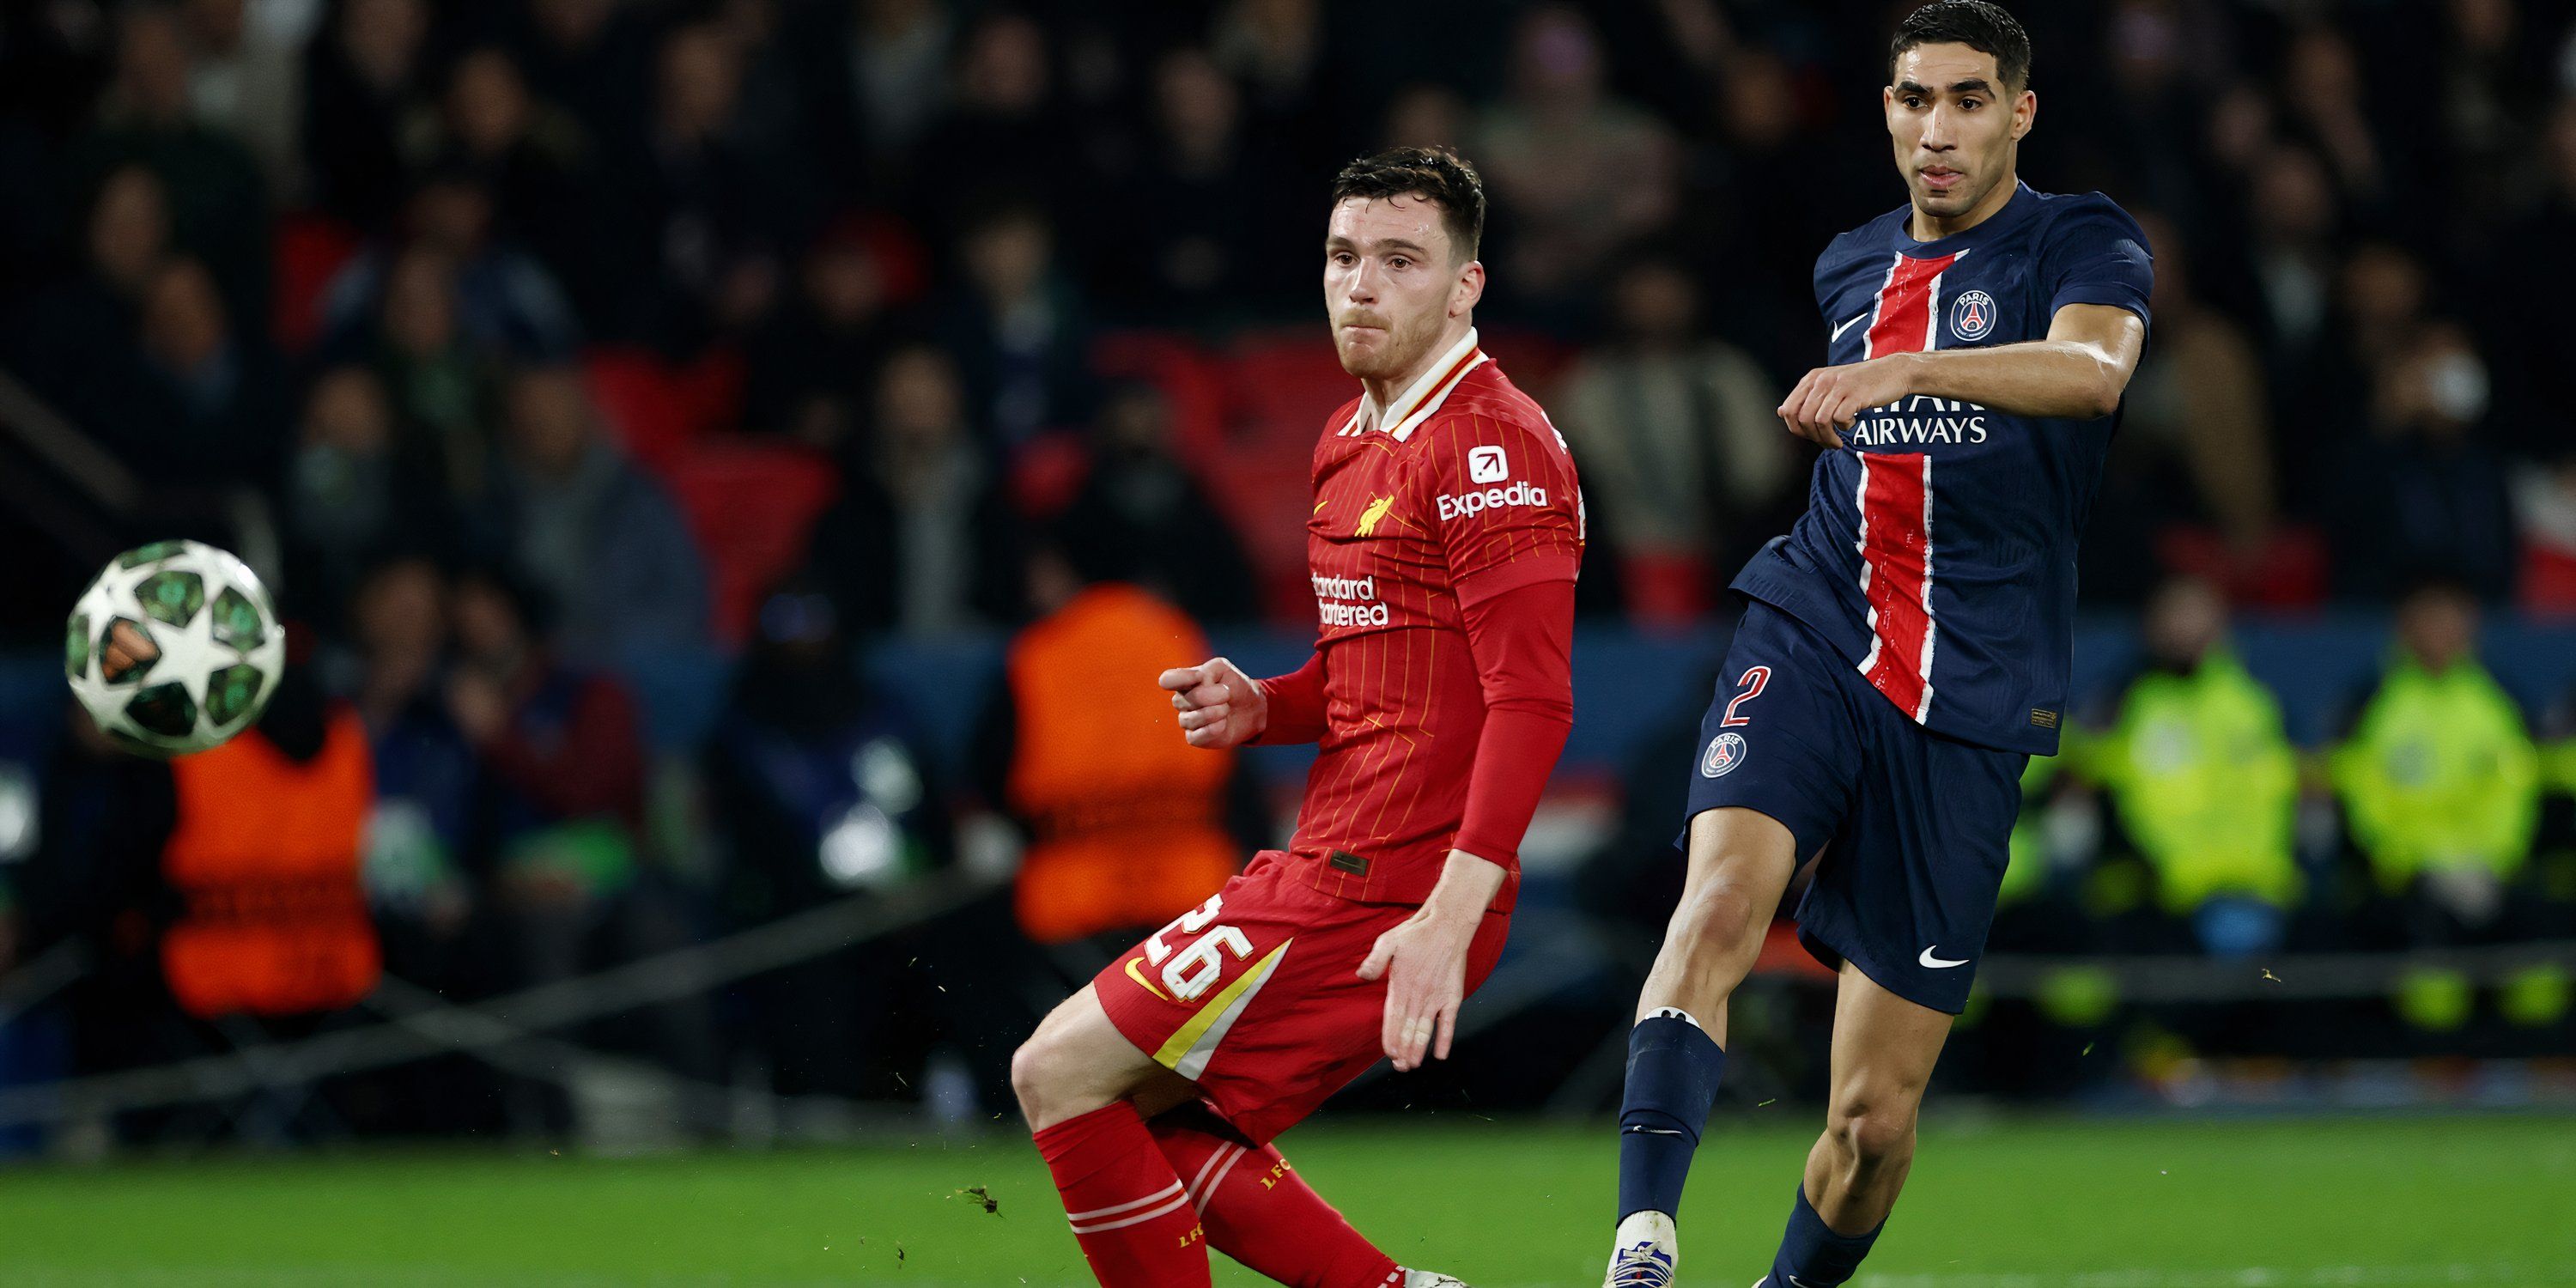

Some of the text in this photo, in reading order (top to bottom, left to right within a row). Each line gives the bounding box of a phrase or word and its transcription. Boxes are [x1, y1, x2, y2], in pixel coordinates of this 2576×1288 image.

[1959, 292, 1990, 306] PARIS
[1853, 416, 1987, 446] AIRWAYS
[1437, 481, 1547, 521] Expedia
[1311, 571, 1375, 600] tandard
[1719, 665, 1772, 728] 2
[1710, 734, 1741, 749] PARIS
[1143, 892, 1255, 1004] 26
[1260, 1157, 1291, 1191] LFC
